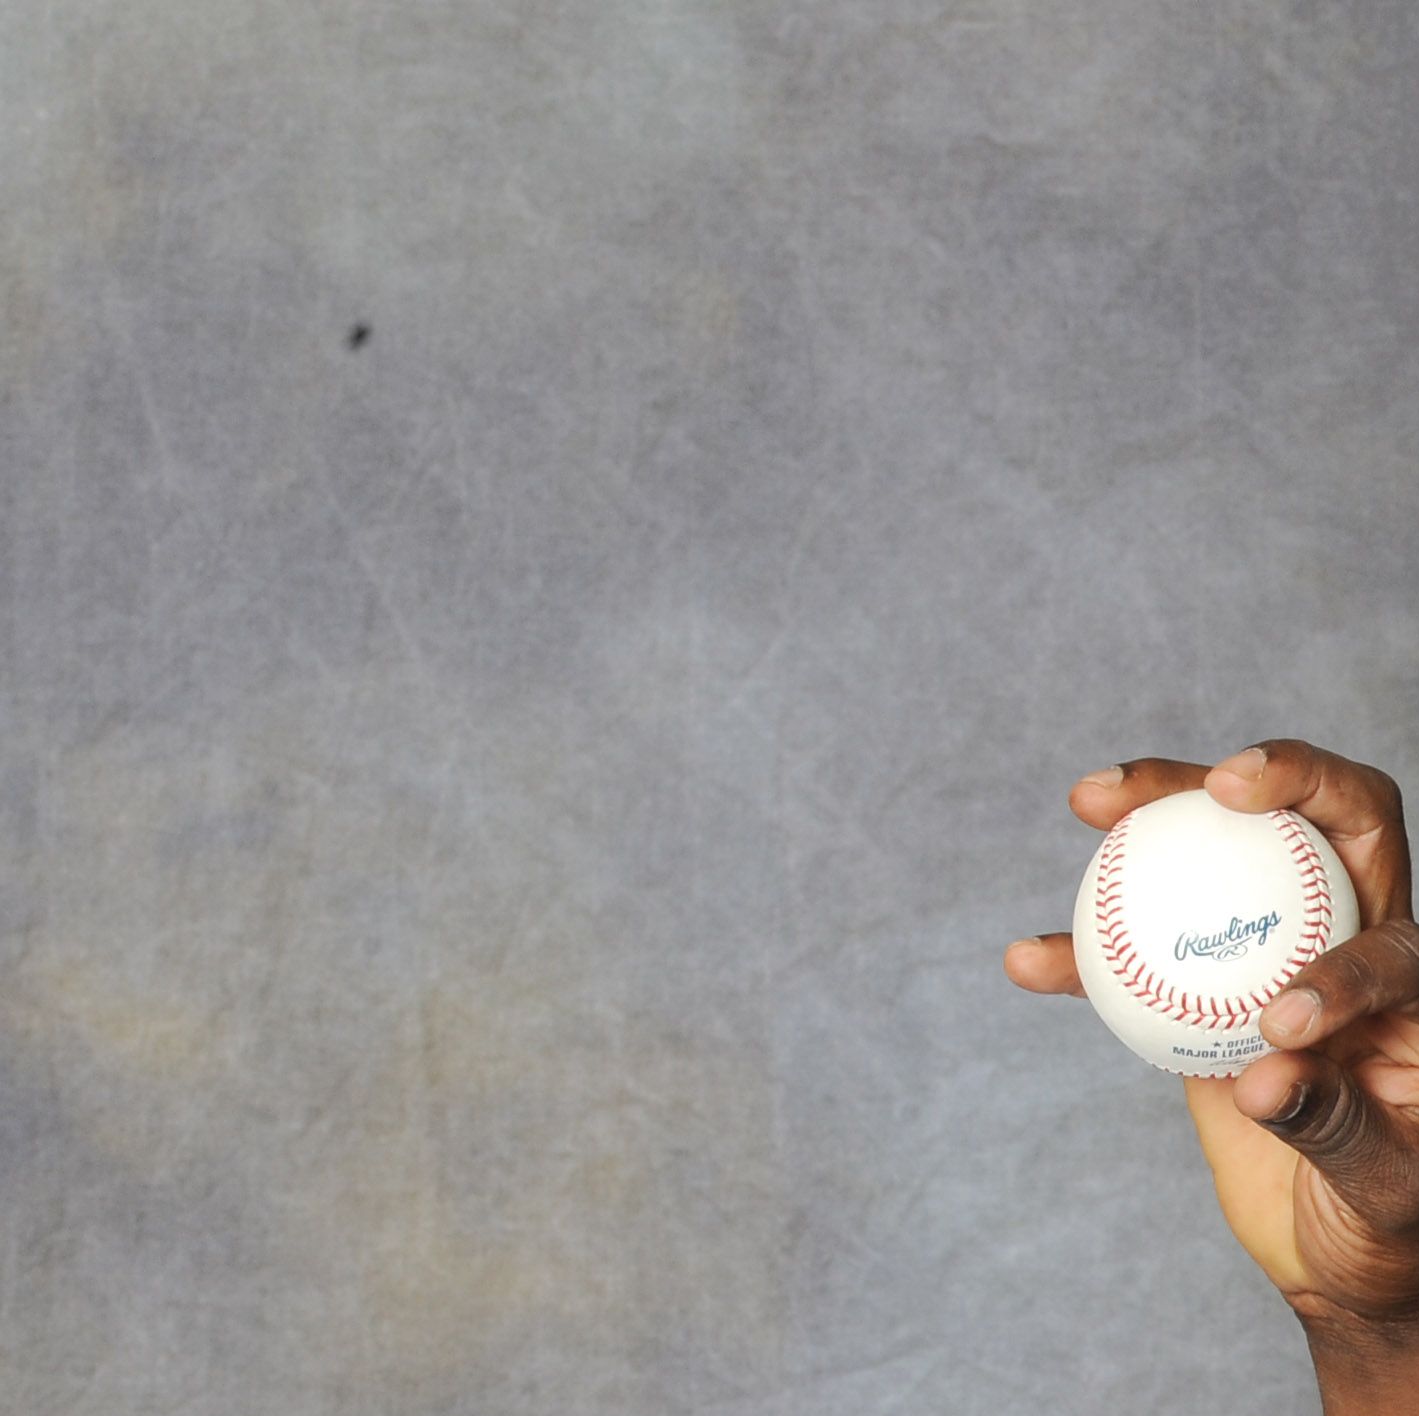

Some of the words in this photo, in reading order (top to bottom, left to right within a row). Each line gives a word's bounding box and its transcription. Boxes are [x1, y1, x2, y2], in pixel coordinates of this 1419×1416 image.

[1174, 910, 1283, 961] Rawlings
[1227, 1035, 1265, 1048] OFFICI
[1172, 1046, 1218, 1059] MAJOR
[1222, 1042, 1265, 1058] LEAGUE
